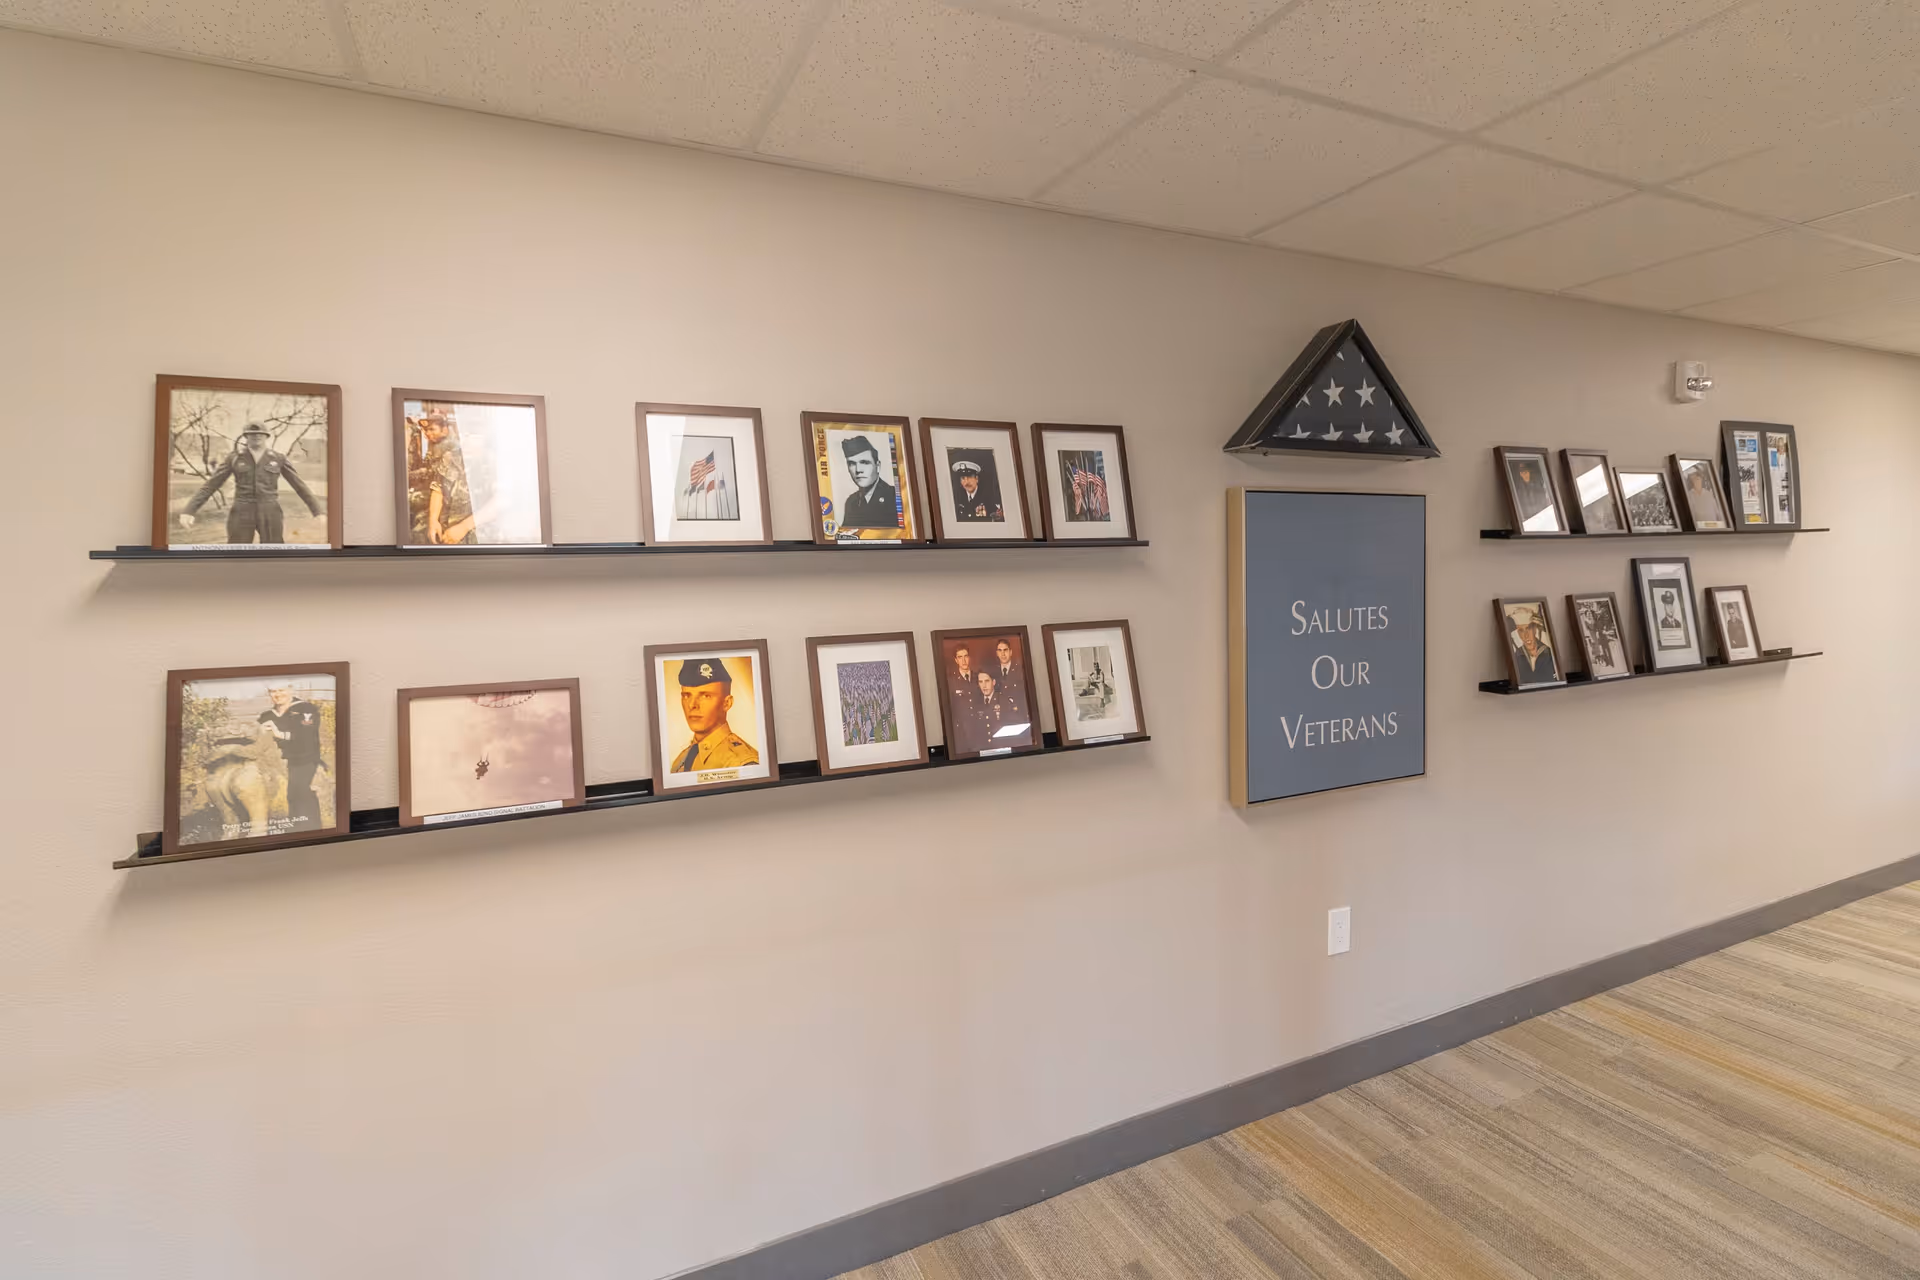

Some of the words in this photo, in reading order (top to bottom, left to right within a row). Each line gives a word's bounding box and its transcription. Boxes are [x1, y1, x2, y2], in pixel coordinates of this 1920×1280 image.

[817, 428, 827, 457] FORCE
[820, 461, 828, 477] AIR
[1291, 600, 1389, 635] SALUTES
[1311, 655, 1370, 689] OUR
[1280, 711, 1398, 749] VETERANS
